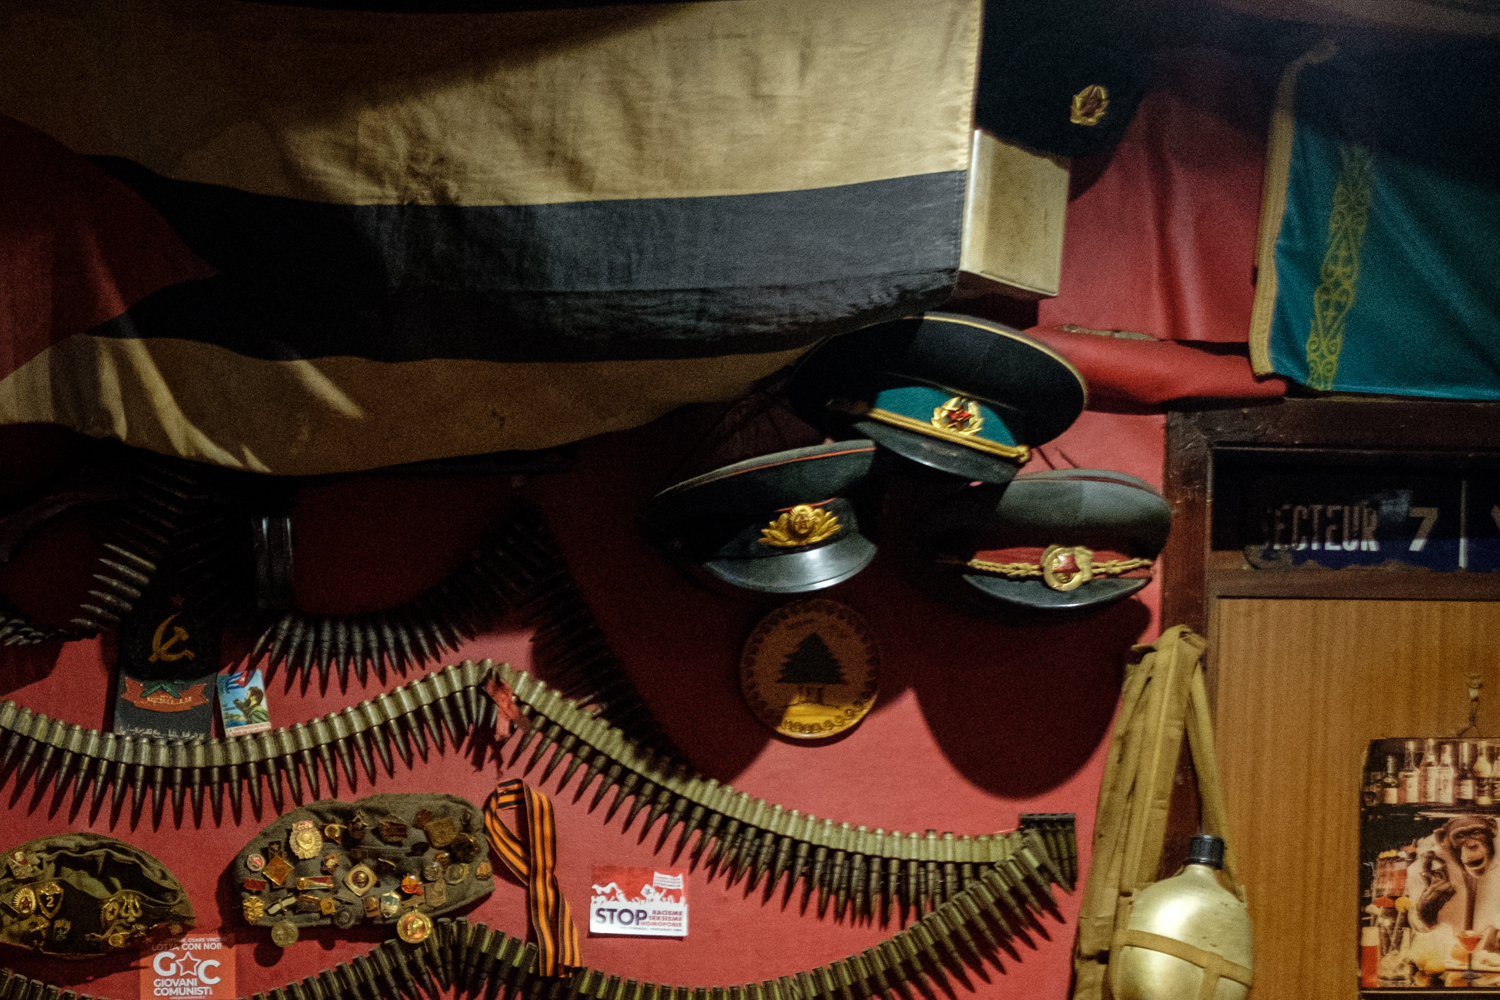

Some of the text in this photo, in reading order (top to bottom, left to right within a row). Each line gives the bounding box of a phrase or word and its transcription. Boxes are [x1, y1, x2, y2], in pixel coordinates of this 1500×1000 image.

[1266, 503, 1380, 552] ECTEUR
[1408, 506, 1440, 552] 7
[46, 896, 55, 908] 2
[595, 907, 648, 926] STOP
[181, 942, 201, 951] CON
[153, 978, 198, 988] GIOVANI
